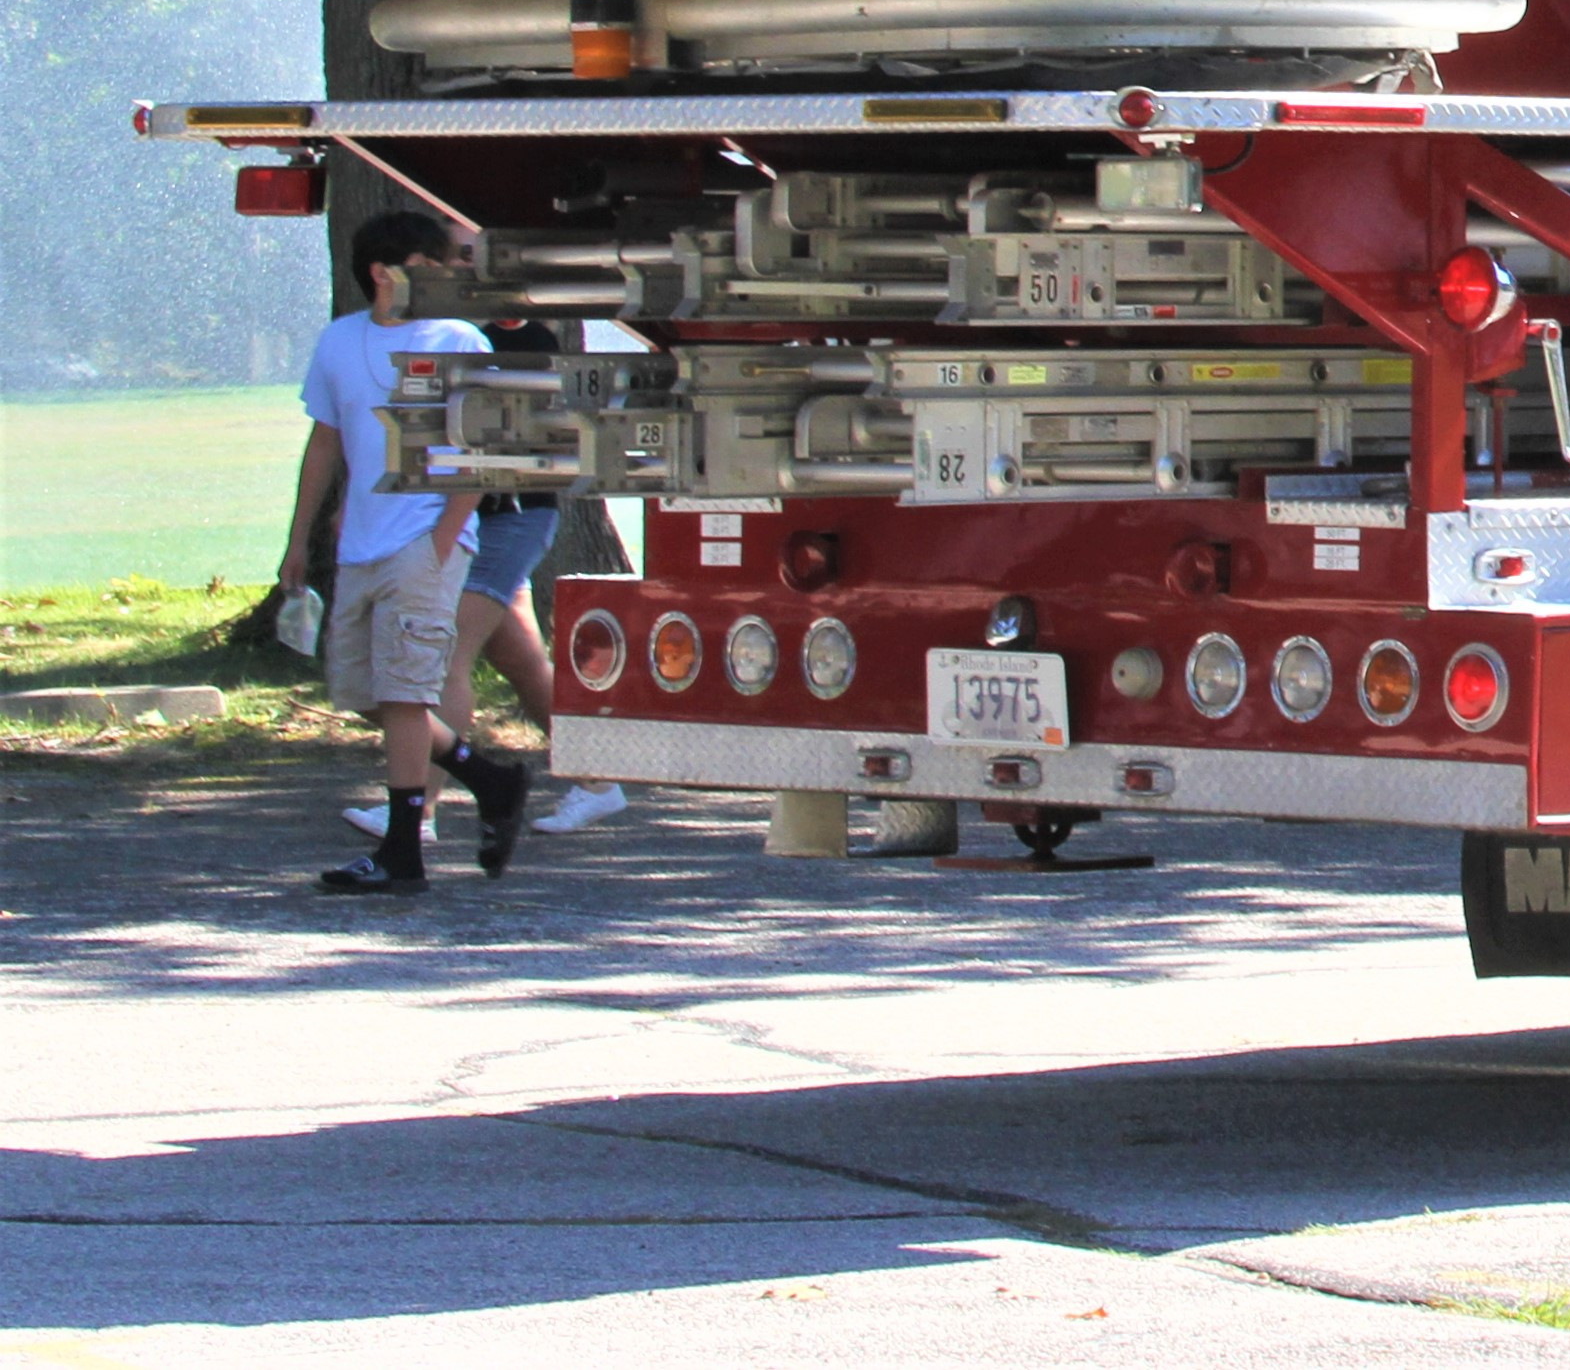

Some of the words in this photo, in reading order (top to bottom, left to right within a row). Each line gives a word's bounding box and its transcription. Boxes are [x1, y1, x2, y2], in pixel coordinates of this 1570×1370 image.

[1029, 274, 1058, 304] 50
[574, 370, 599, 397] 18
[941, 365, 959, 384] 16
[641, 426, 661, 443] 28
[962, 655, 995, 670] Rhode
[953, 675, 1041, 723] 13975
